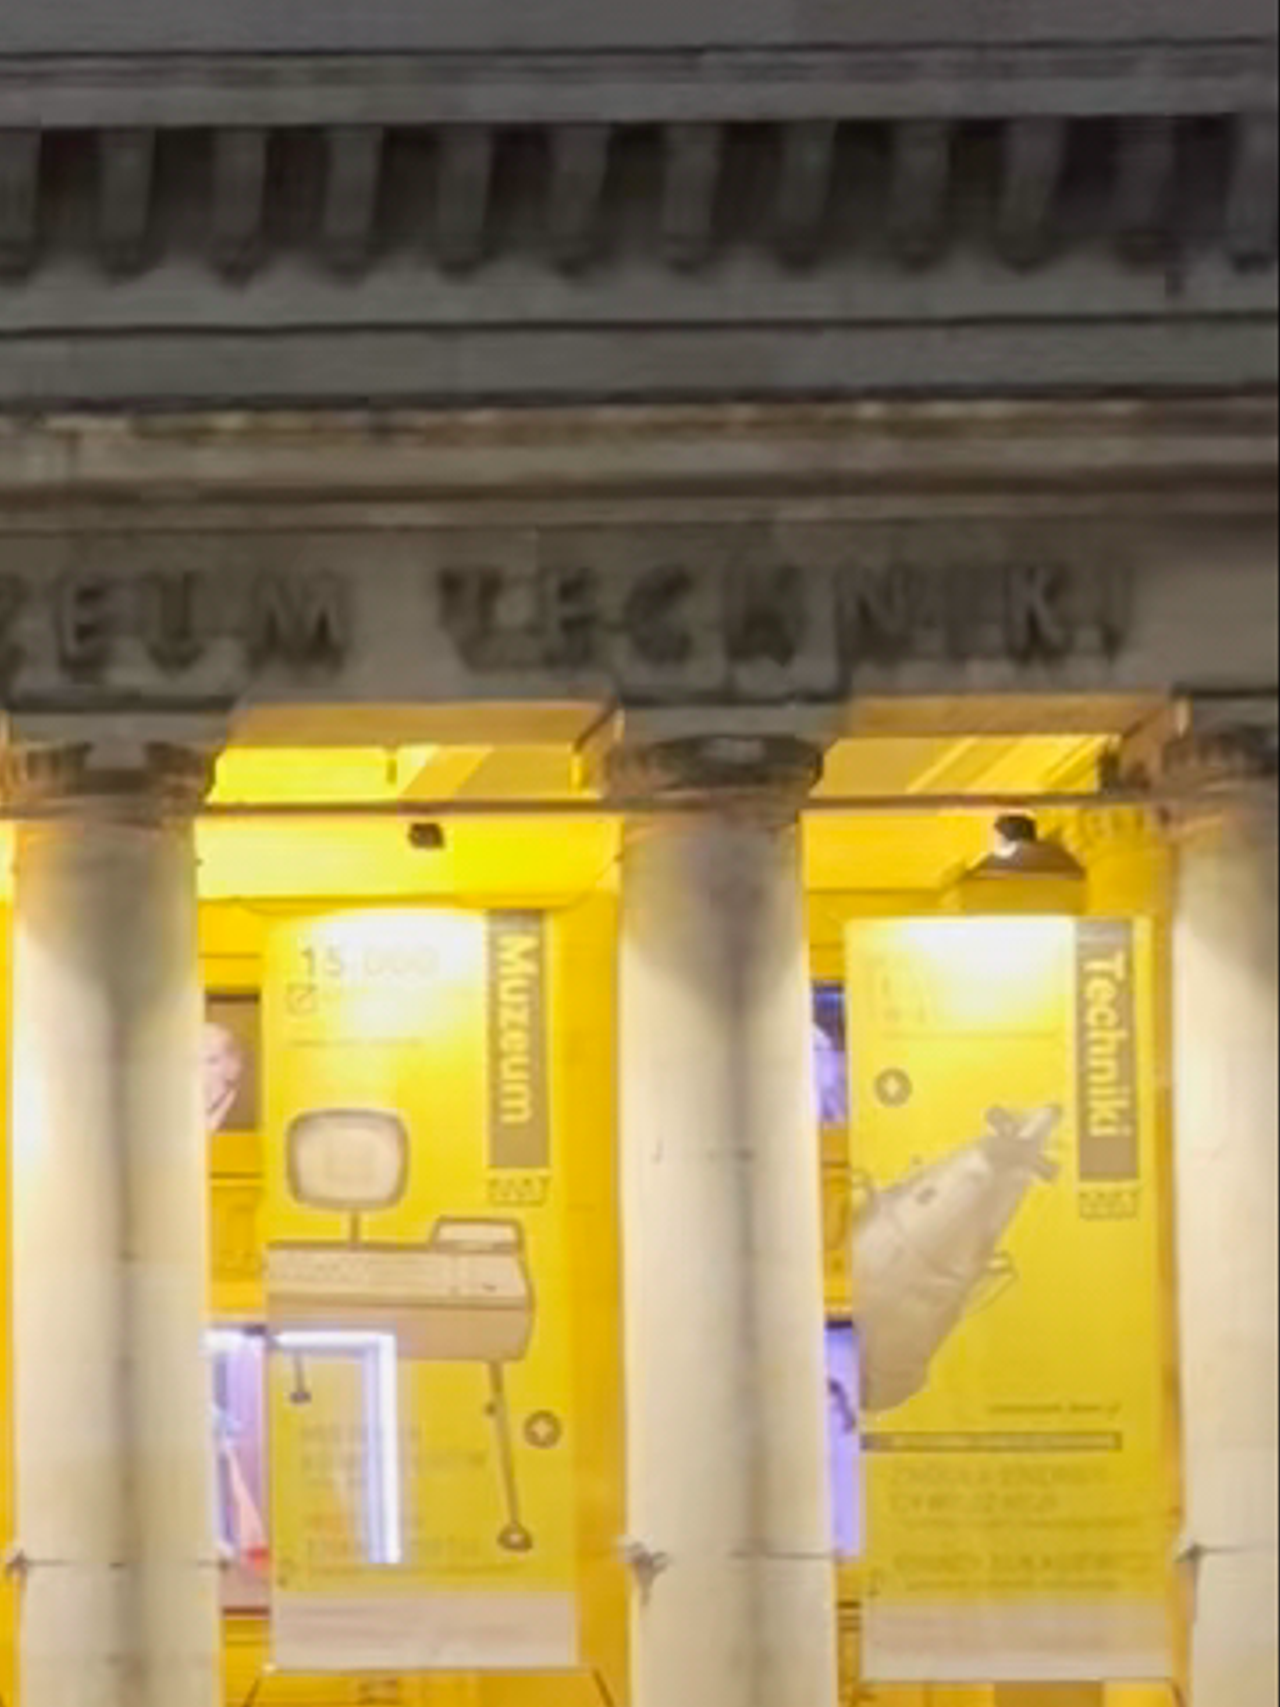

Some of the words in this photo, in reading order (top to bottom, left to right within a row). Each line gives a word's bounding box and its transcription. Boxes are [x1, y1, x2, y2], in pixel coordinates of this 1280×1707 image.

[438, 563, 1130, 671] TECHNIKI
[497, 934, 540, 1124] Muzeum
[1083, 951, 1132, 1138] Techniki
